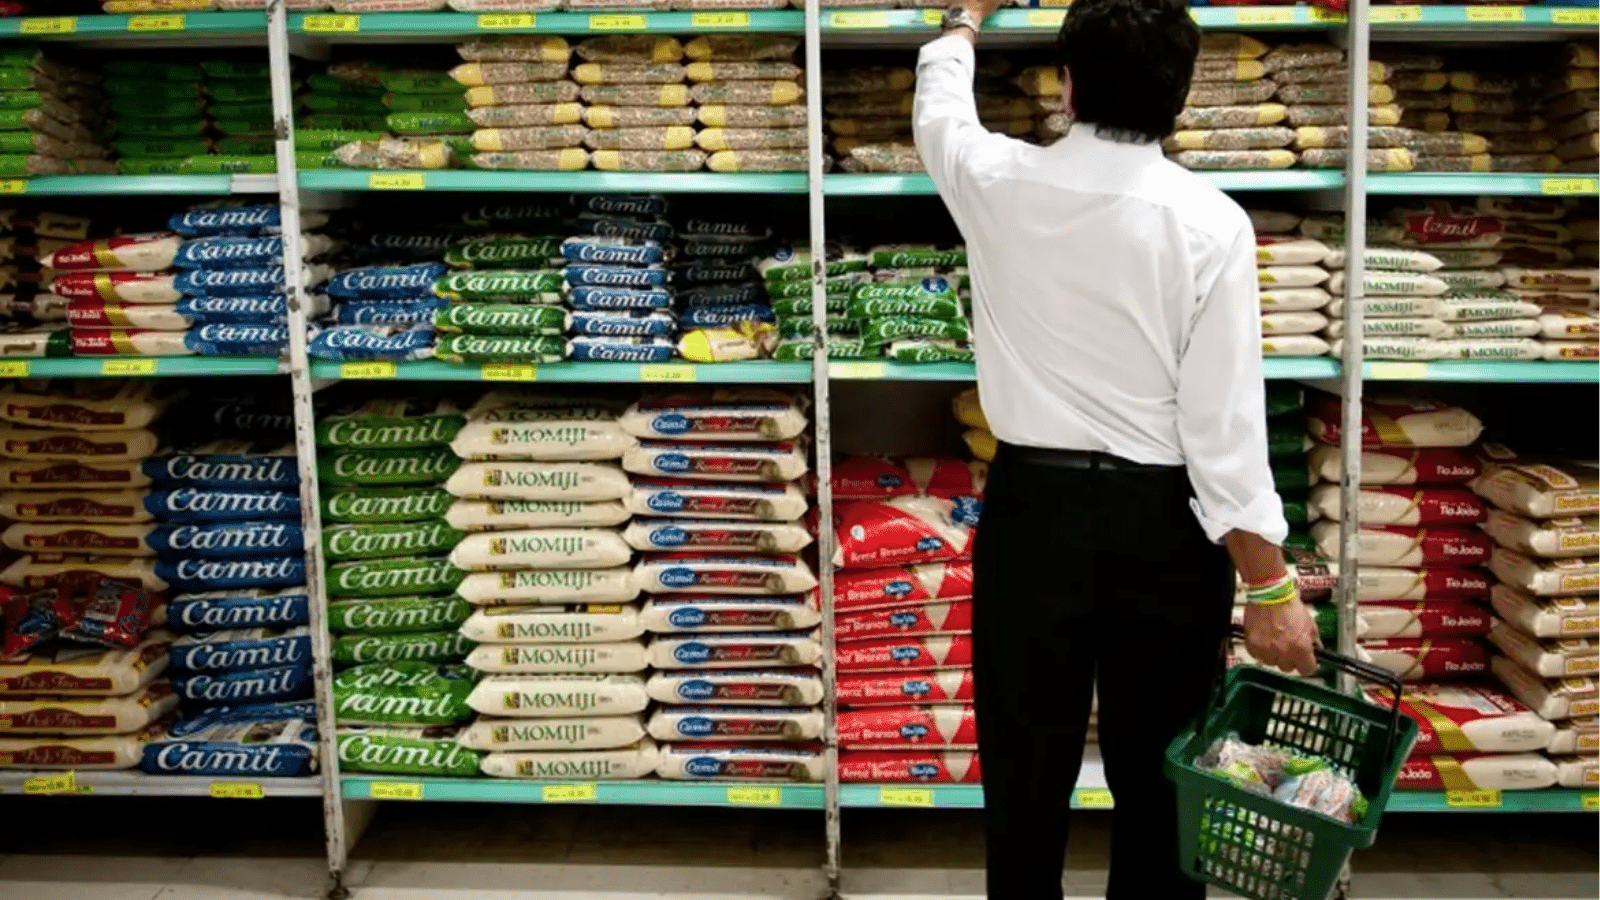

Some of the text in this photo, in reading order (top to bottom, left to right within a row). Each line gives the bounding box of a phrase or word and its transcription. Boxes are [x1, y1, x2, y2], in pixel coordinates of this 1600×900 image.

[588, 197, 651, 214] Camil
[183, 205, 268, 226] Camil
[593, 222, 658, 239] Camil
[1423, 216, 1478, 236] Camil
[186, 237, 282, 260] Camil
[463, 240, 551, 261] Camil
[579, 246, 647, 263] Camil
[892, 253, 956, 267] Camil
[190, 266, 285, 286] Camil
[343, 269, 430, 290] Camil
[450, 274, 545, 292] Camil
[581, 268, 650, 285] Camil
[586, 291, 654, 309] Camil
[857, 285, 921, 299] Camil
[189, 296, 285, 313] Camil
[865, 298, 933, 315] Camil
[1467, 308, 1513, 318] MOMIJI
[451, 305, 545, 325] Camil
[585, 318, 654, 336] Camil
[881, 320, 947, 338] Camil
[326, 331, 416, 350] Camil
[452, 334, 546, 354] Camil
[588, 343, 656, 360] Camil
[328, 418, 446, 445] Camil
[654, 418, 688, 430] Camil
[512, 427, 586, 446] MOMIJI
[167, 456, 286, 482] Camil
[335, 452, 450, 476] Camil
[656, 458, 690, 470] Camil
[502, 471, 578, 491] MOMIJI
[167, 488, 287, 512] Camil
[328, 491, 445, 517] Camil
[506, 501, 582, 516] MOMIJI
[649, 496, 683, 508] Camil
[169, 523, 288, 549] Camil
[330, 525, 446, 555] Camil
[651, 531, 687, 543] Camil
[510, 537, 583, 556] MOMIJI
[177, 557, 298, 580] Camil
[339, 562, 456, 590] Camil
[518, 568, 593, 588] MOMIJI
[661, 571, 695, 584] Camil
[181, 598, 297, 626] Camil
[344, 599, 460, 628] Camil
[671, 612, 705, 624] Camil
[518, 622, 591, 640] MOMIJI
[185, 638, 301, 670] Camil
[353, 633, 470, 663] Camil
[522, 648, 596, 665] MOMIJI
[675, 647, 709, 659] Camil
[186, 670, 295, 700] Camil
[680, 685, 714, 698] Camil
[523, 692, 597, 711] MOMIJI
[512, 726, 586, 744] MOMIJI
[678, 721, 712, 733] Camil
[157, 743, 282, 772] Camil
[339, 735, 465, 769] Camil
[536, 761, 611, 778] MOMIJI
[686, 761, 722, 774] Camil
